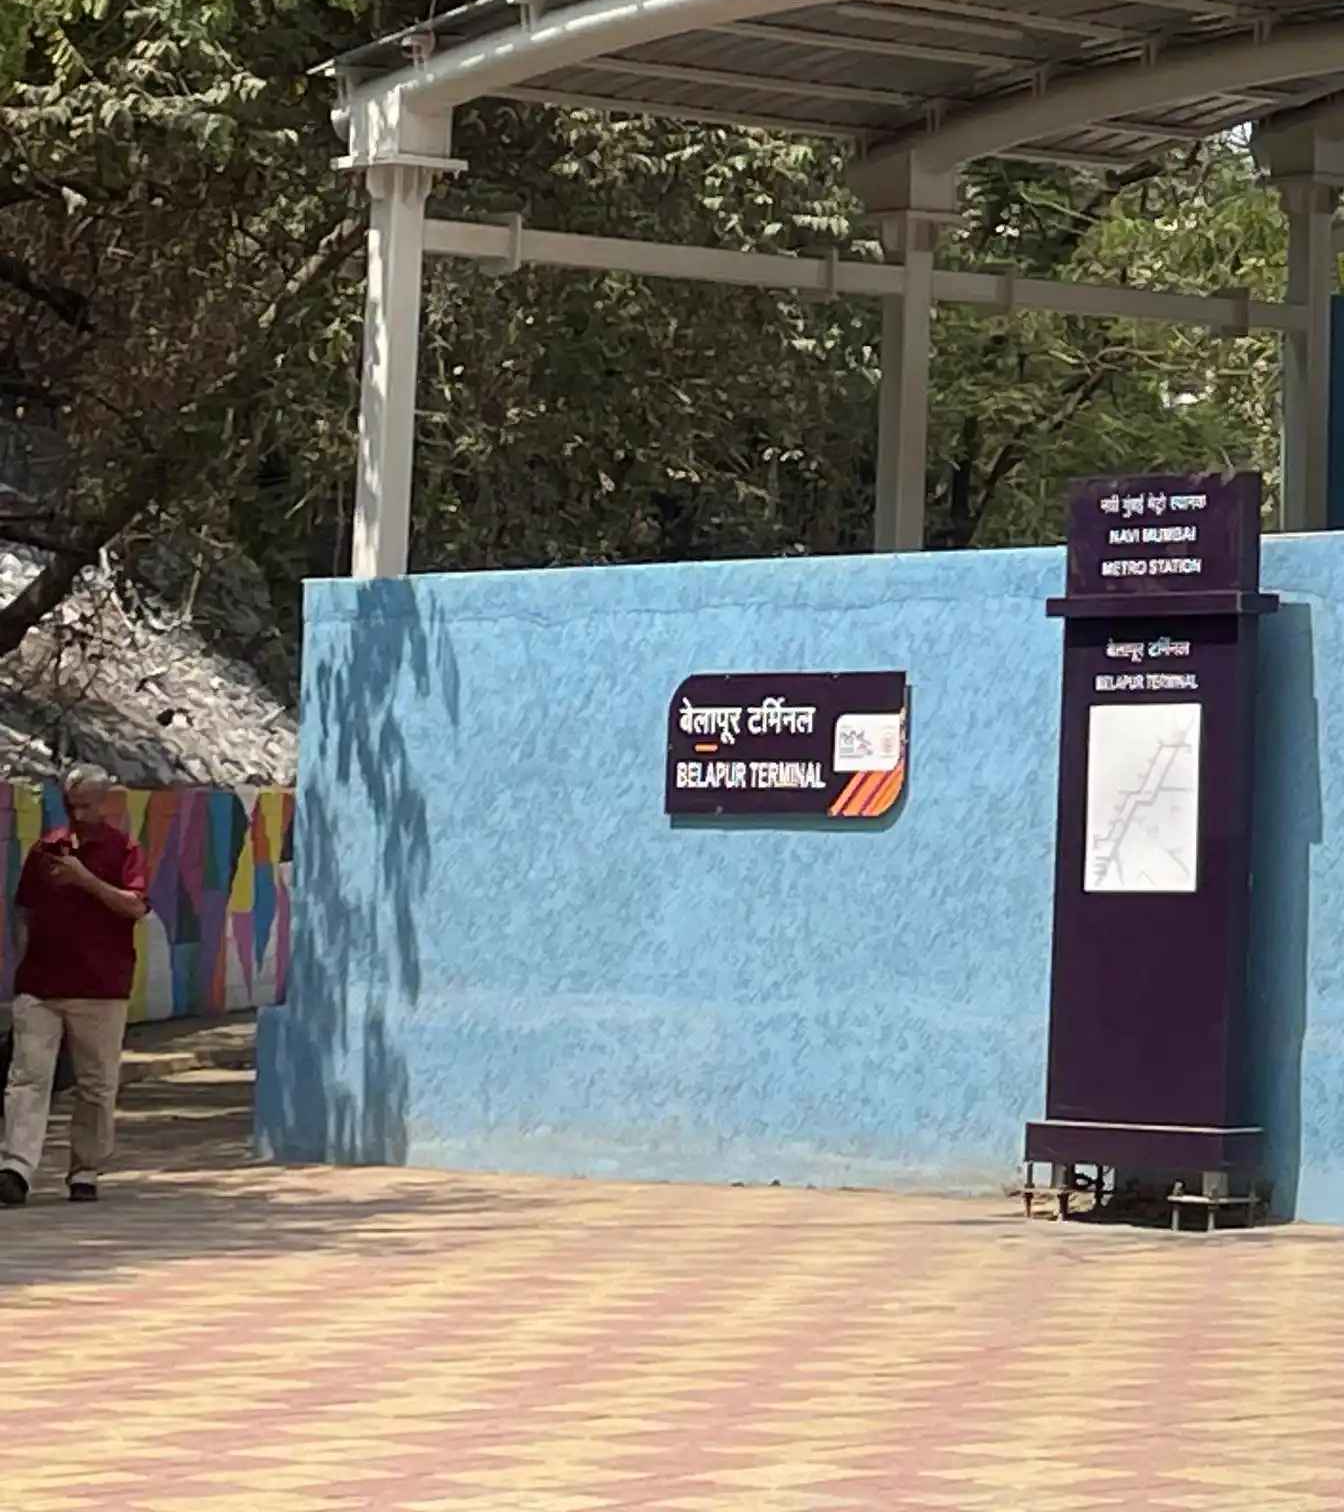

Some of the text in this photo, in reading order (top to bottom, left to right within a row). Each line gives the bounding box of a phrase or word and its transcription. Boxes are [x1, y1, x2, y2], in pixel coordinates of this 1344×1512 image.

[1108, 526, 1197, 545] NAVI MUMBAI
[1101, 557, 1203, 577] METRO STATION
[679, 696, 817, 745] बेलापूर टर्मिनल
[675, 760, 827, 789] BELAPUR TERMINAL
